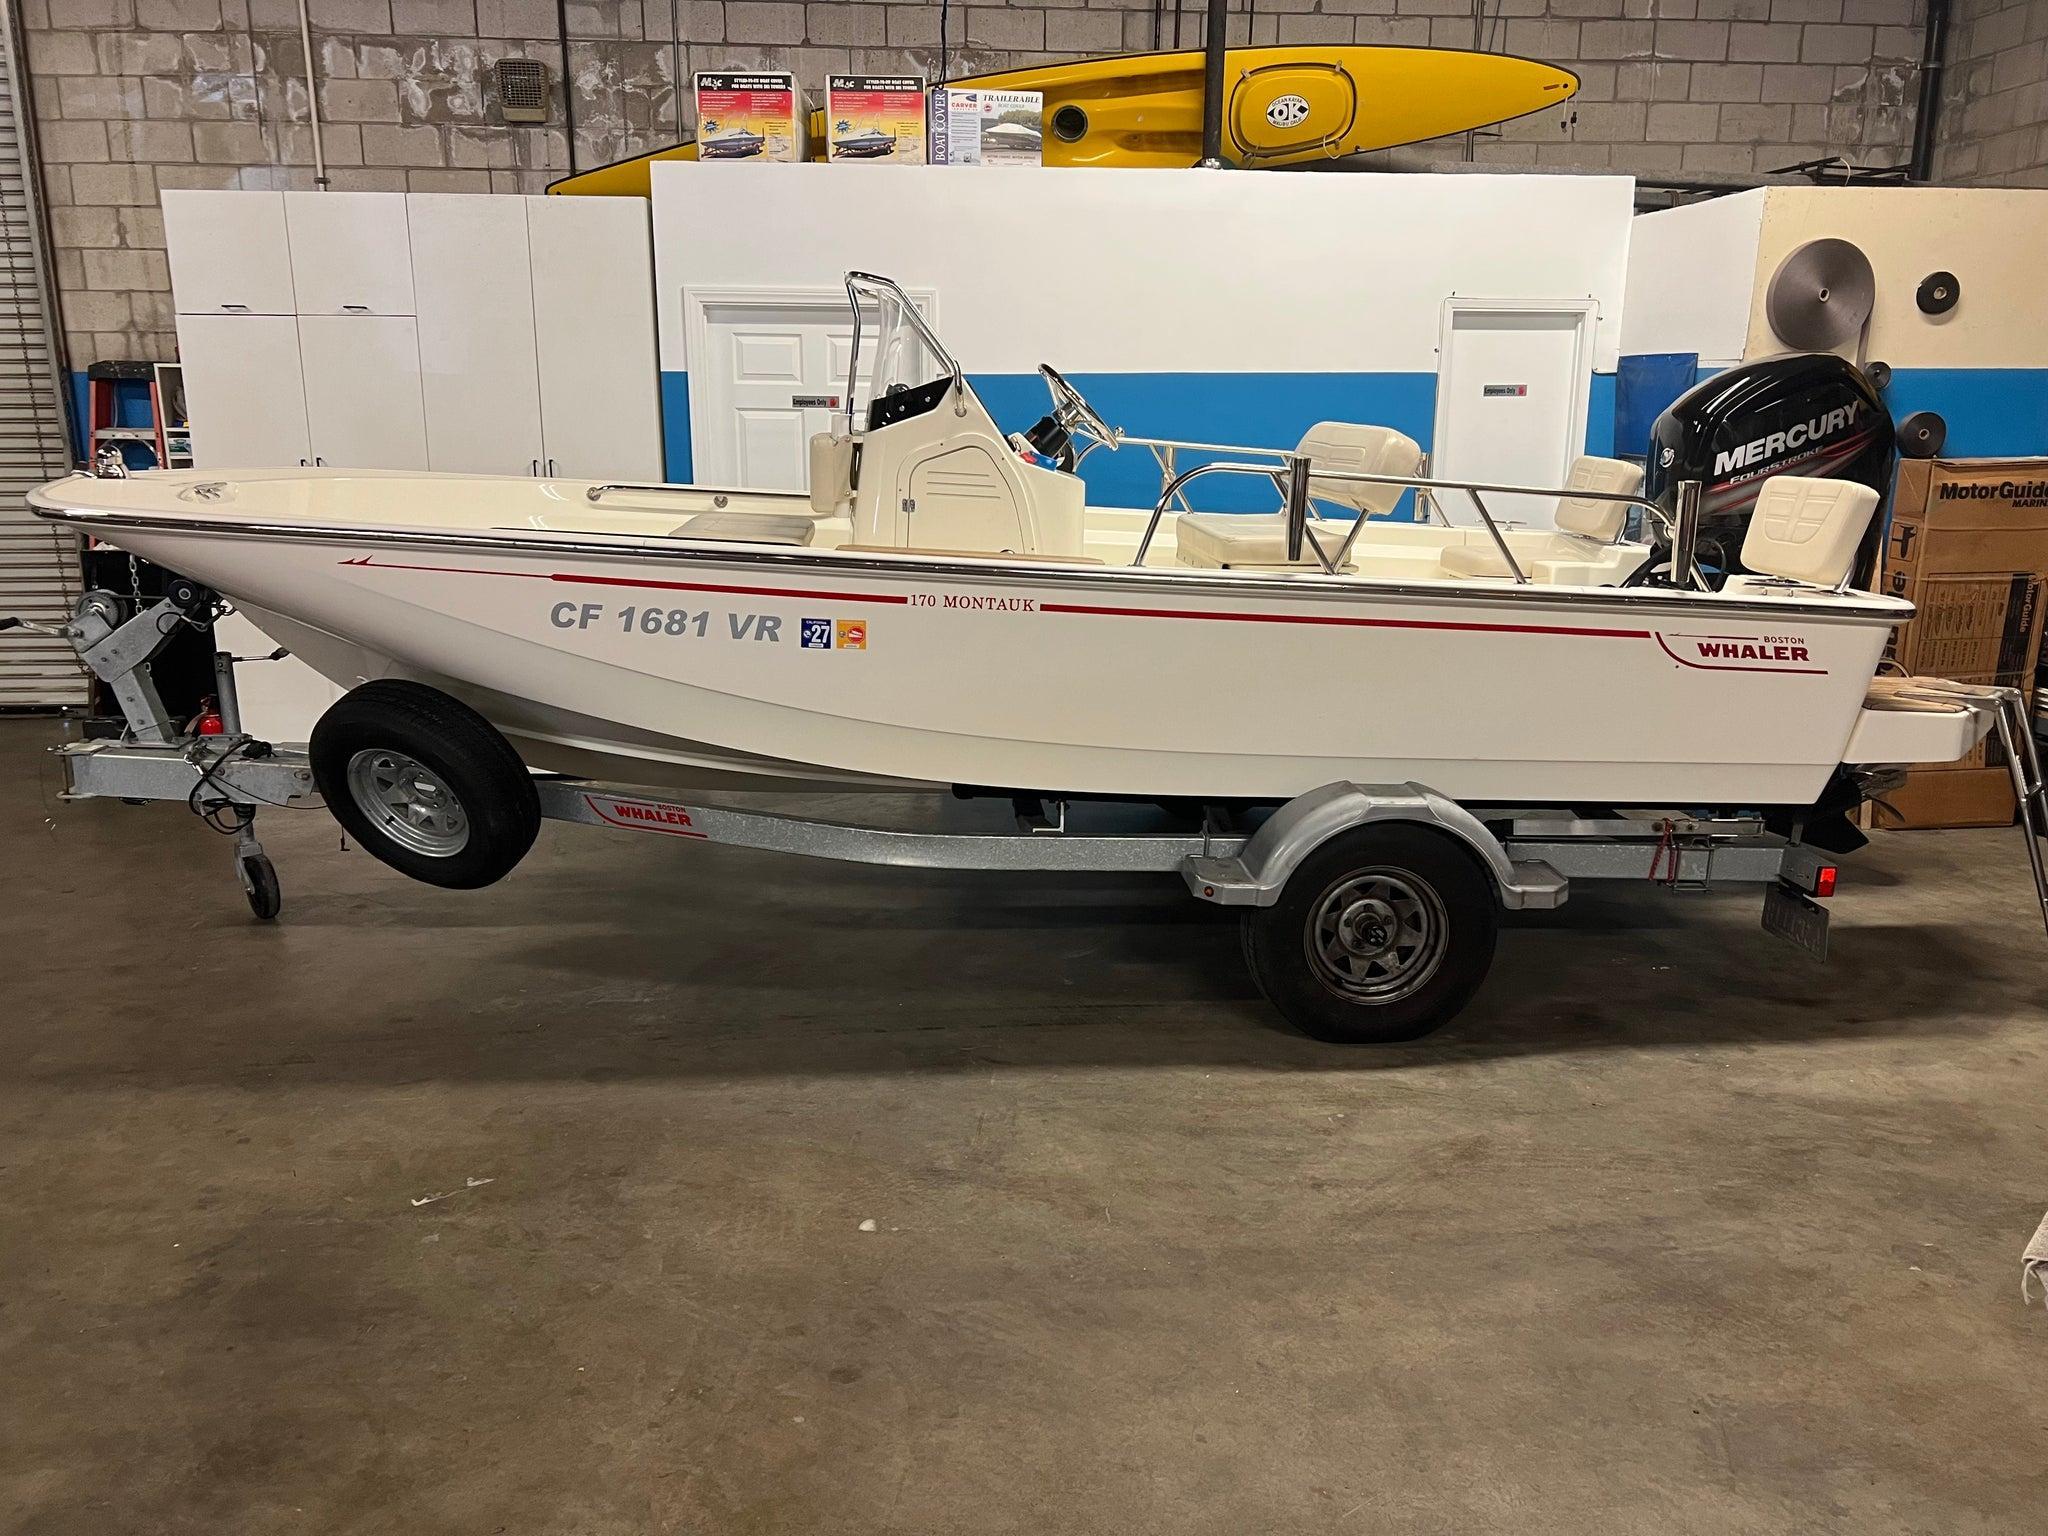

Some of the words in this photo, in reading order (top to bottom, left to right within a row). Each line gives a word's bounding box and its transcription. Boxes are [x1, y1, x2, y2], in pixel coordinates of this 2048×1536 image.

[983, 94, 1040, 103] TRAILERABLE
[1272, 98, 1287, 107] OCEAN
[935, 93, 946, 131] COVER
[935, 133, 946, 161] BOAT
[1506, 387, 1516, 395] Only
[816, 398, 827, 407] Only
[1713, 401, 1858, 476] MERCURY
[1729, 445, 1824, 485] FOURSTROKE
[1939, 481, 2048, 500] MotorGuid
[2012, 499, 2048, 507] MARIN
[911, 594, 936, 607] 170
[943, 595, 1035, 612] MONTAUK
[550, 601, 603, 629] CF
[617, 606, 710, 637] 1681
[727, 613, 782, 642] VR
[811, 624, 830, 643] 27
[1763, 635, 1805, 645] BOSTON
[1697, 642, 1810, 662] WHALER
[614, 805, 692, 827] WHALER
[656, 804, 686, 813] BOSTON
